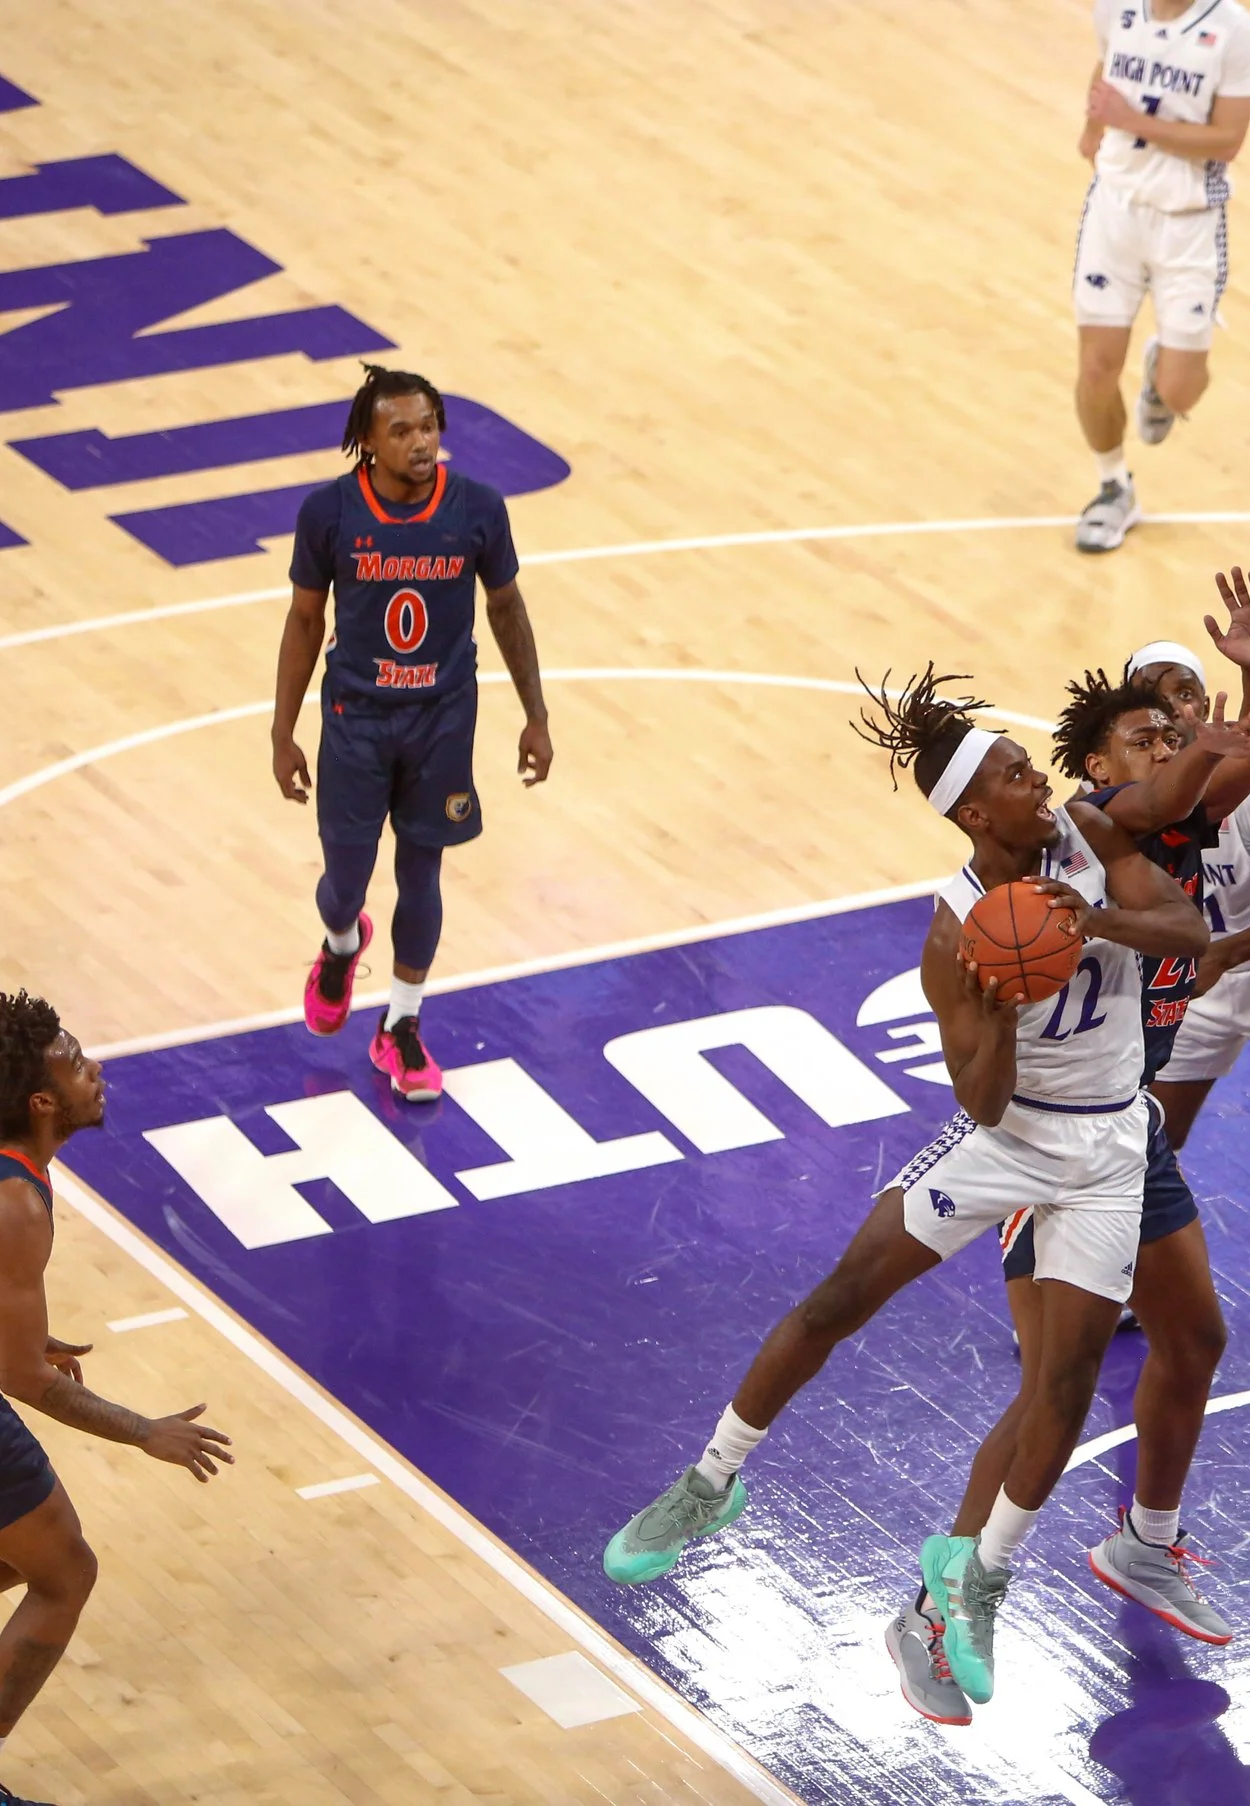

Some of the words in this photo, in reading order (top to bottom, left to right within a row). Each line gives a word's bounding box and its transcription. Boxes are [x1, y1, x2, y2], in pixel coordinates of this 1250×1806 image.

[1109, 53, 1146, 83] HIGH
[1149, 62, 1205, 97] POINT
[350, 551, 464, 581] MORGAN
[384, 587, 428, 654] 0
[373, 656, 438, 688] STATE
